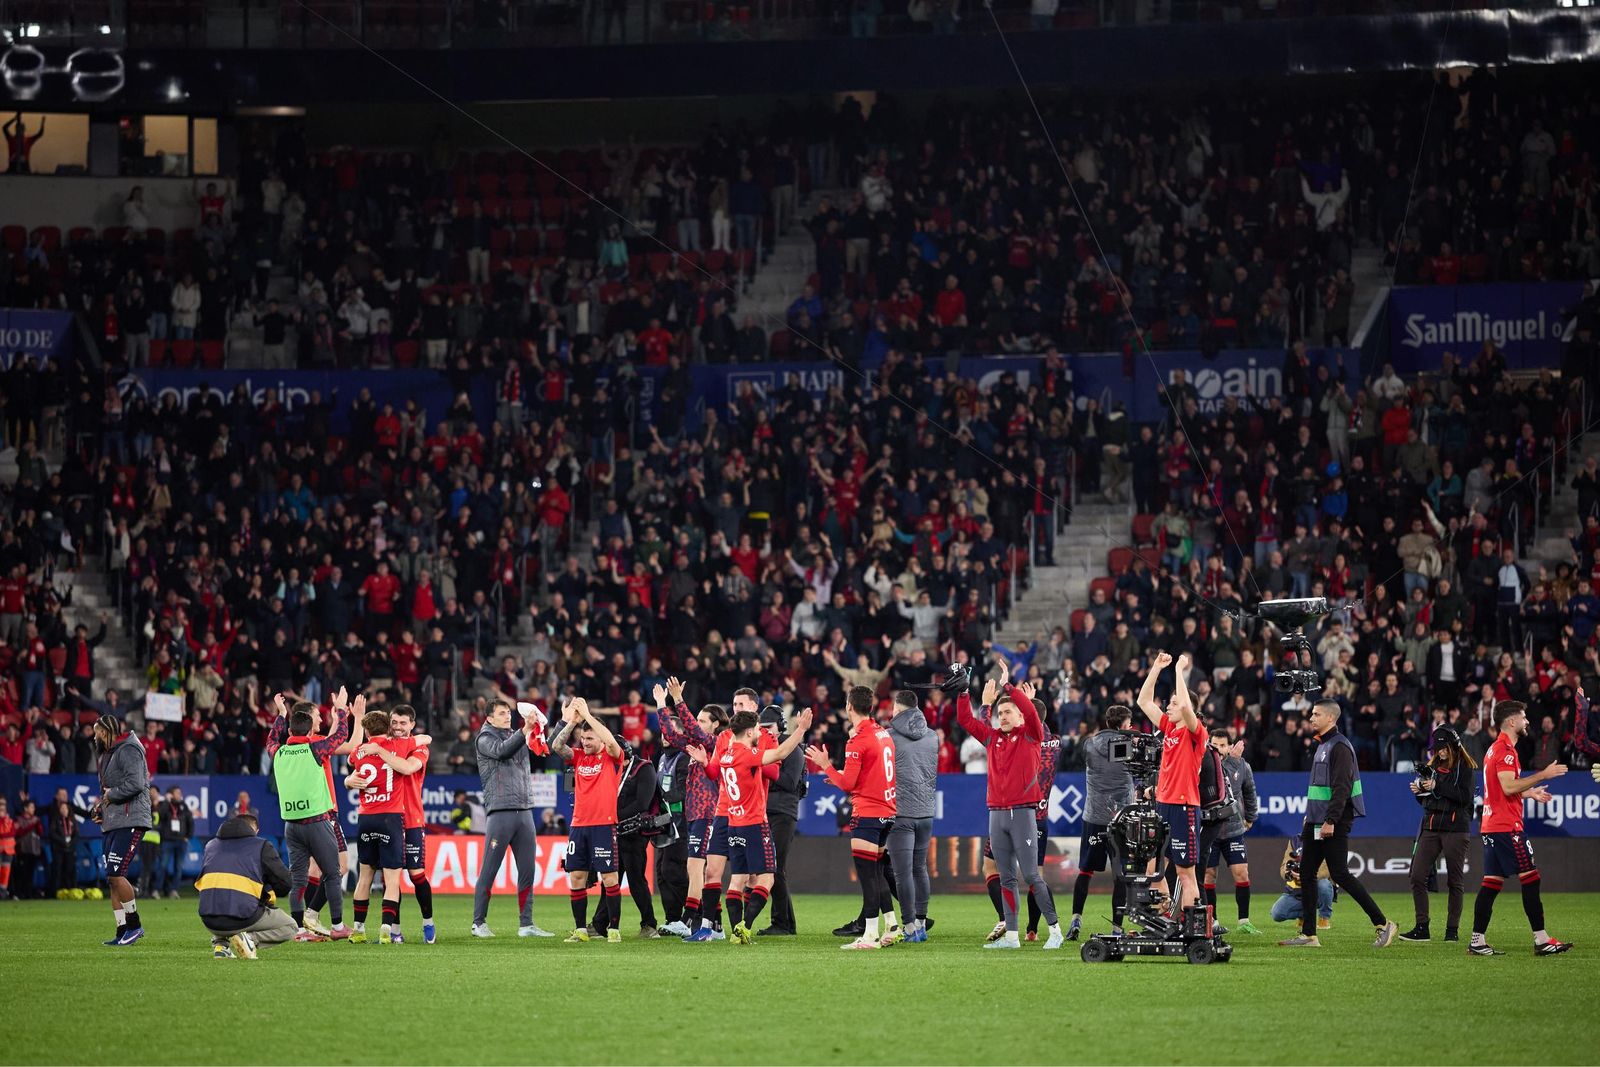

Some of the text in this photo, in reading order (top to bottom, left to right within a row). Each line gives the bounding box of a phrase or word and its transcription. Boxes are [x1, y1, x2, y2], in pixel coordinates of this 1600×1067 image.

[25, 329, 54, 348] DE
[883, 746, 894, 783] 6
[359, 763, 393, 793] 21
[284, 800, 310, 811] DIGI
[364, 793, 391, 803] DIGI
[1526, 840, 1539, 855] 8
